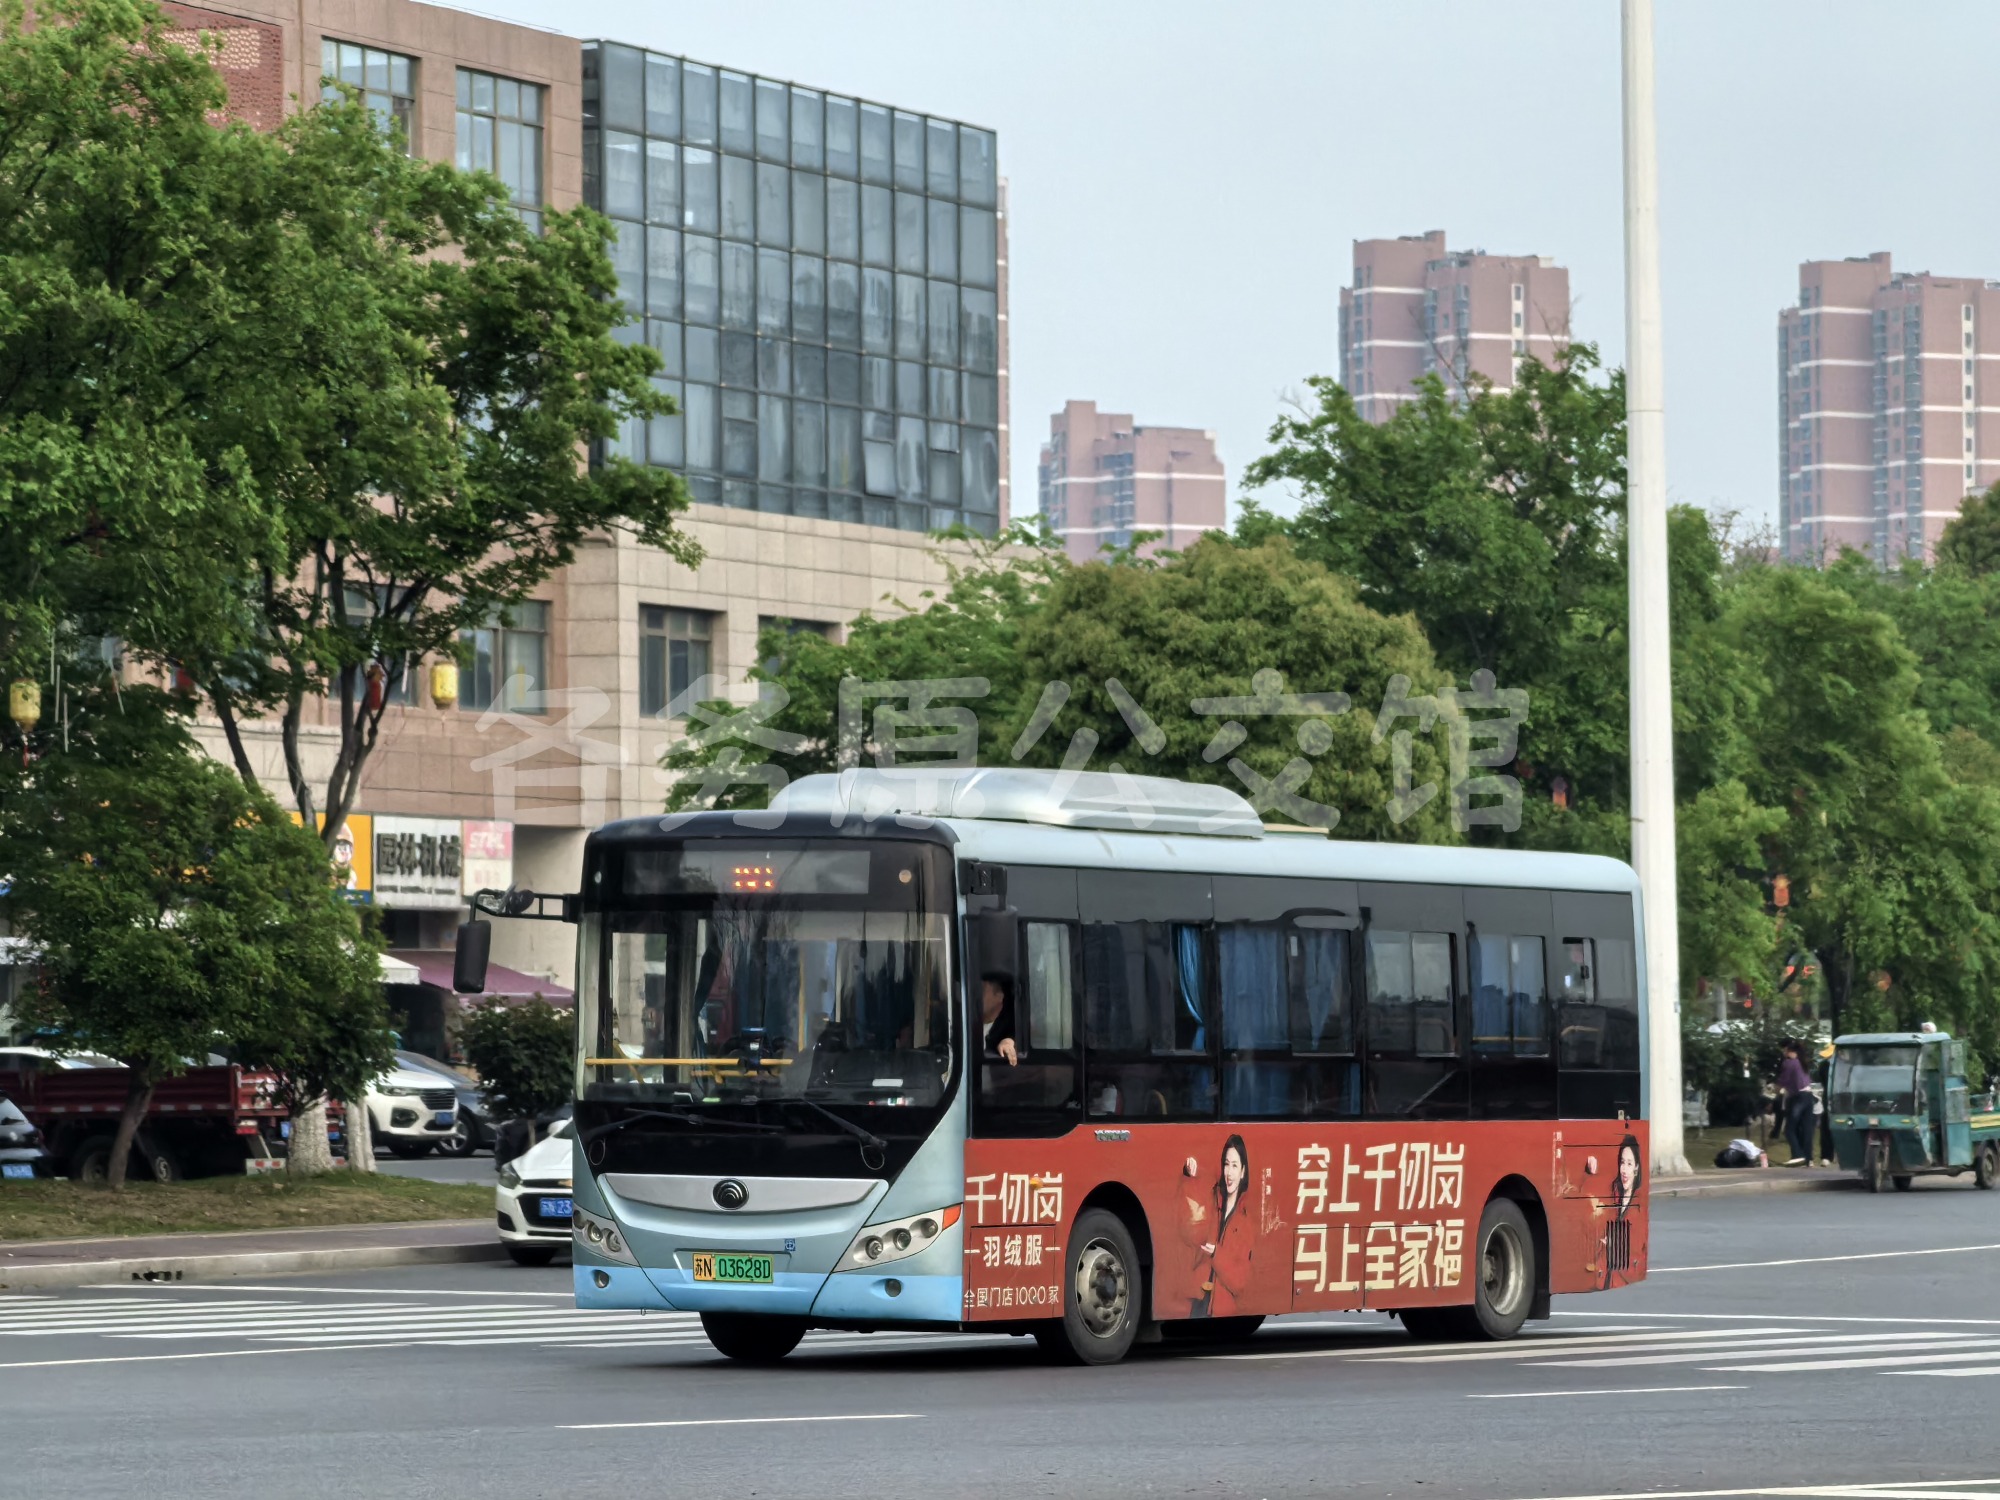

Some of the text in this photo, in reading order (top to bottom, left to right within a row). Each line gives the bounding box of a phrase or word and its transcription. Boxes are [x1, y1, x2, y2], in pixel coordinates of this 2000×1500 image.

[376, 832, 460, 877] 园林机械
[965, 1171, 1063, 1223] 千仞岗
[1296, 1142, 1465, 1214] 穿上千仞岗
[1293, 1219, 1465, 1292] 马上全家福
[964, 1285, 1060, 1308] 全国门店1000家
